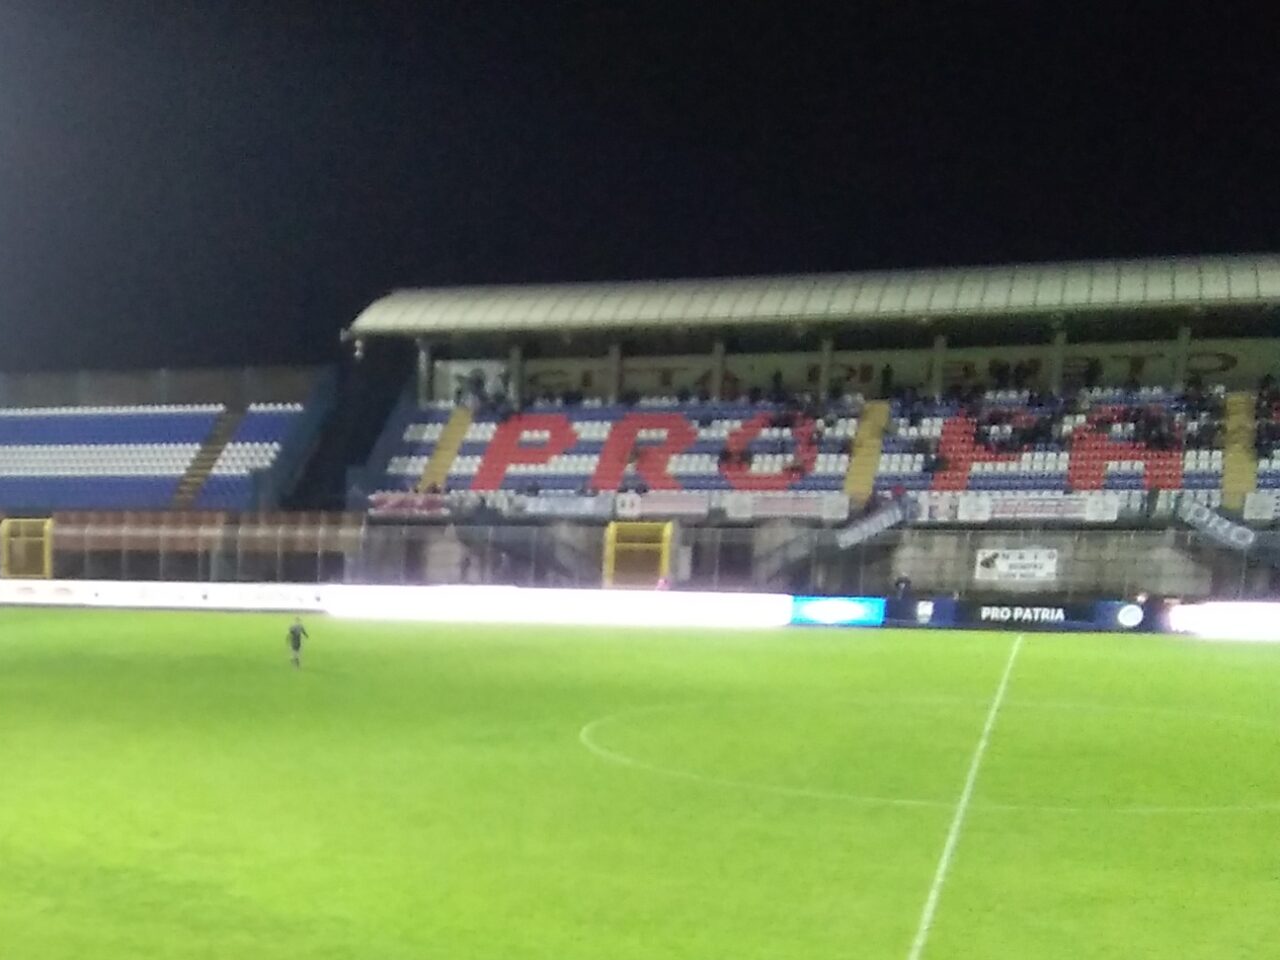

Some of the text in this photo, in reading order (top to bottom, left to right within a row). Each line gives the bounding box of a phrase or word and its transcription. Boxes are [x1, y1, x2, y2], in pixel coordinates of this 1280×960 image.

[470, 411, 818, 491] PRO
[981, 606, 1065, 621] PRO PATRIA
